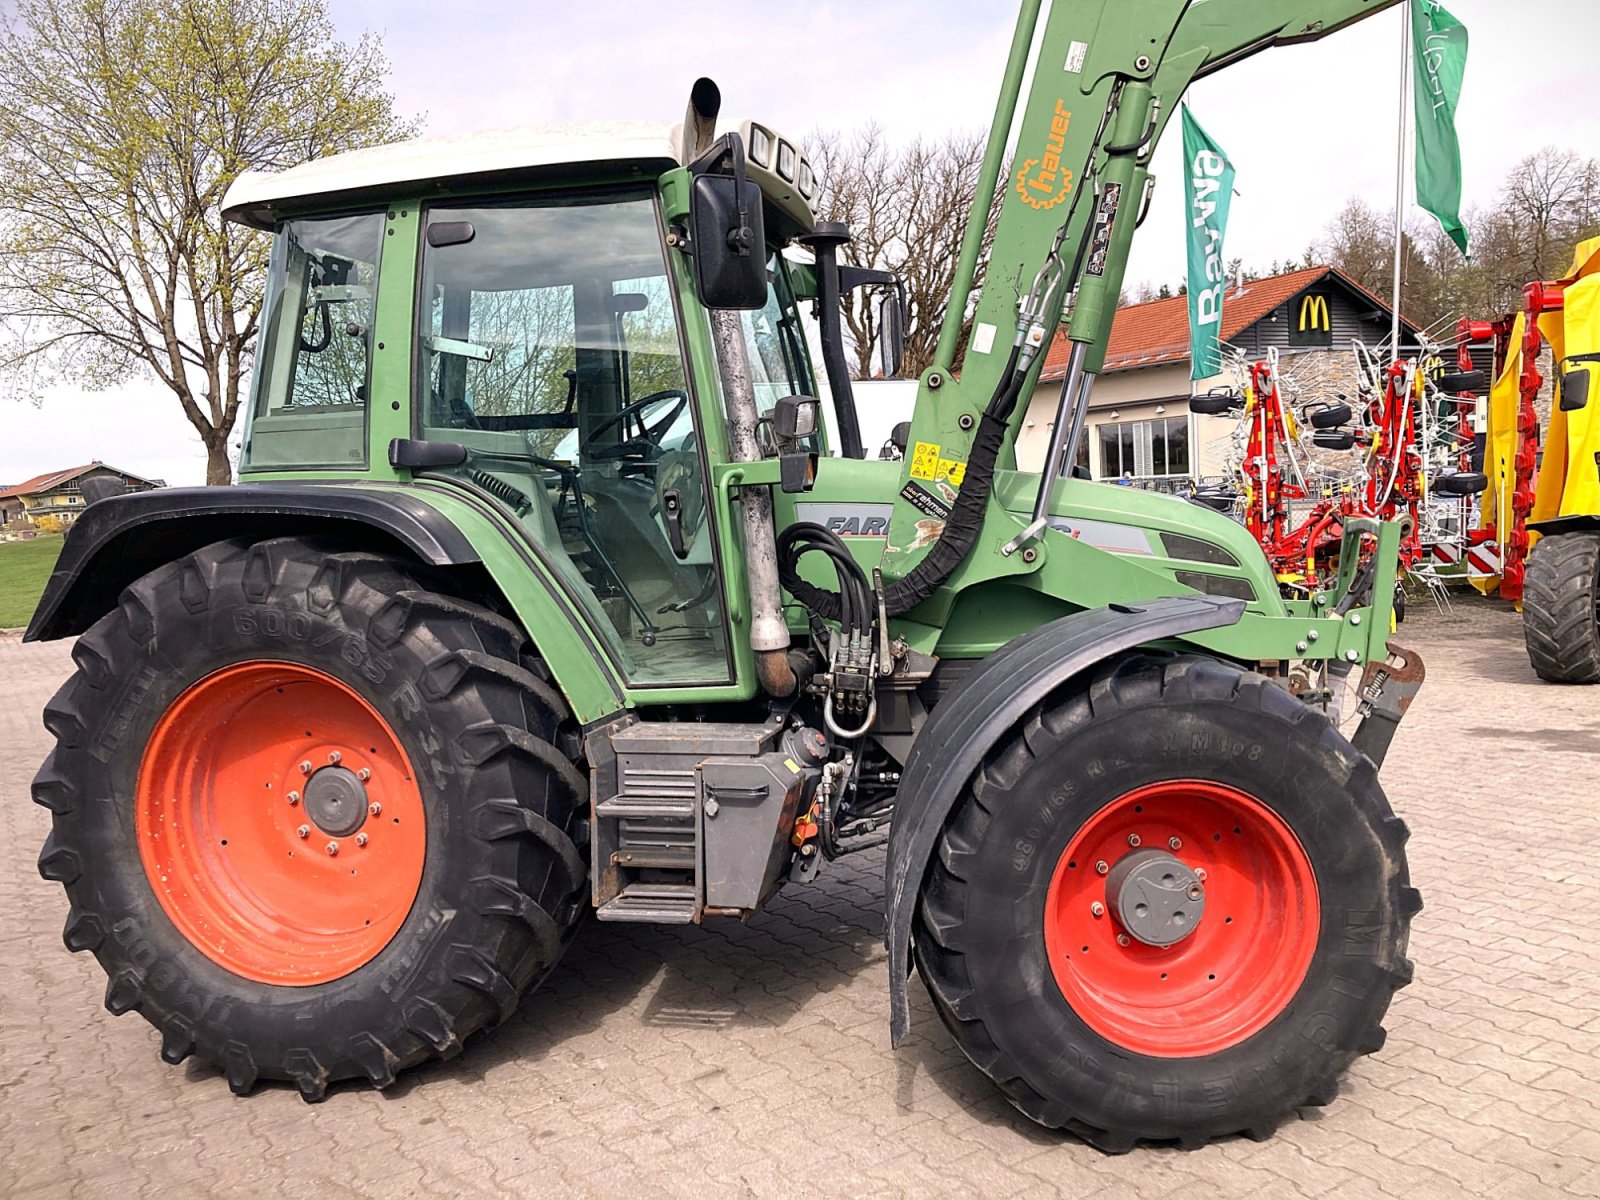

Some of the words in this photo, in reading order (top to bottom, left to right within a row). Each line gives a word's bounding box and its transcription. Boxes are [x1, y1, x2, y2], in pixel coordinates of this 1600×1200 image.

[1028, 98, 1072, 194] hauer
[1298, 294, 1331, 333] M
[232, 607, 394, 685] 600/65
